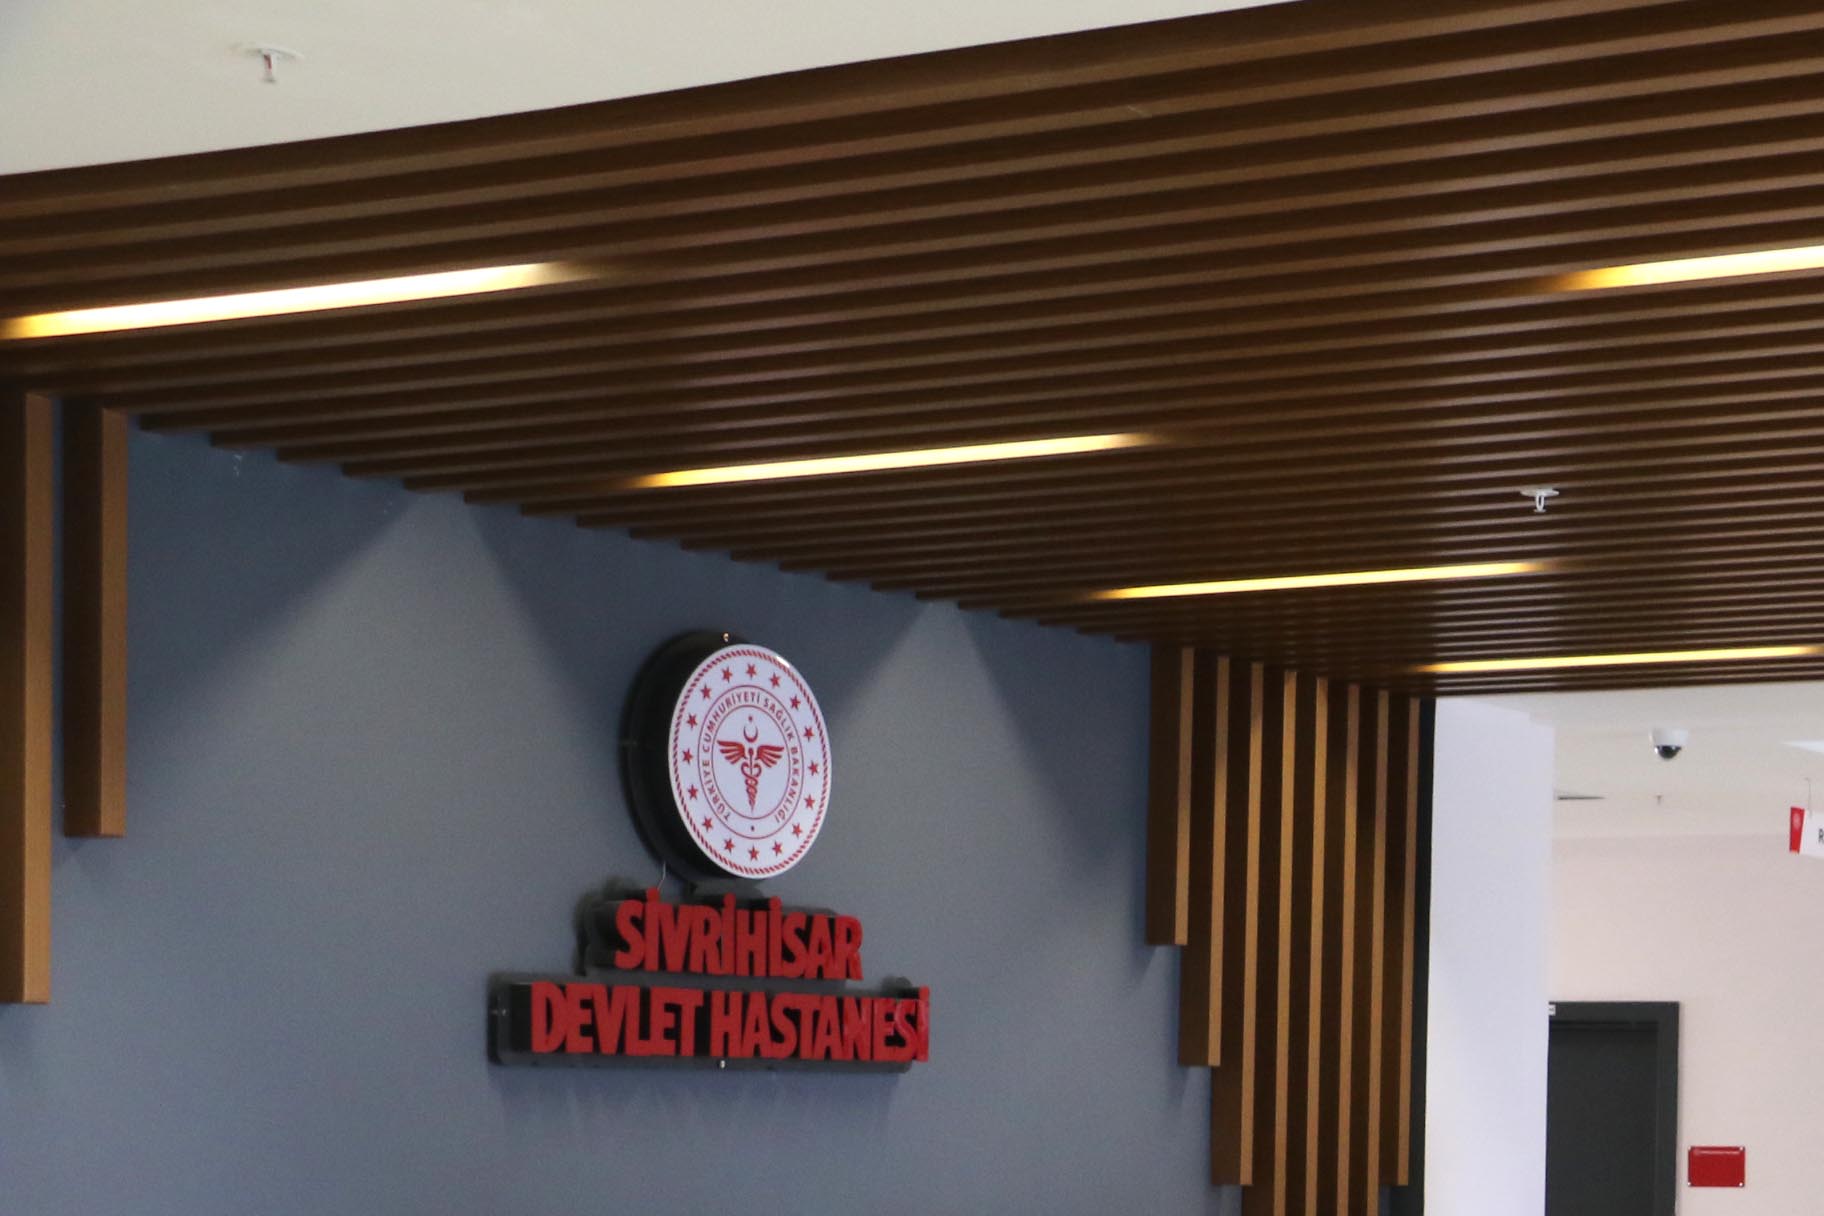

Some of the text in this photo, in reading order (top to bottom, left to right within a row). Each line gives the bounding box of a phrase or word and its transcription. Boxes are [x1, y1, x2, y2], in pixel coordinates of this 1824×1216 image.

[702, 691, 760, 753] CUMHURİYETİ
[763, 698, 795, 741] SAĞLIK
[774, 746, 800, 823] BAKANLIĞI
[614, 887, 863, 981] SİVRİHİSAR
[531, 981, 930, 1063] DEVLET HASTANESİ
